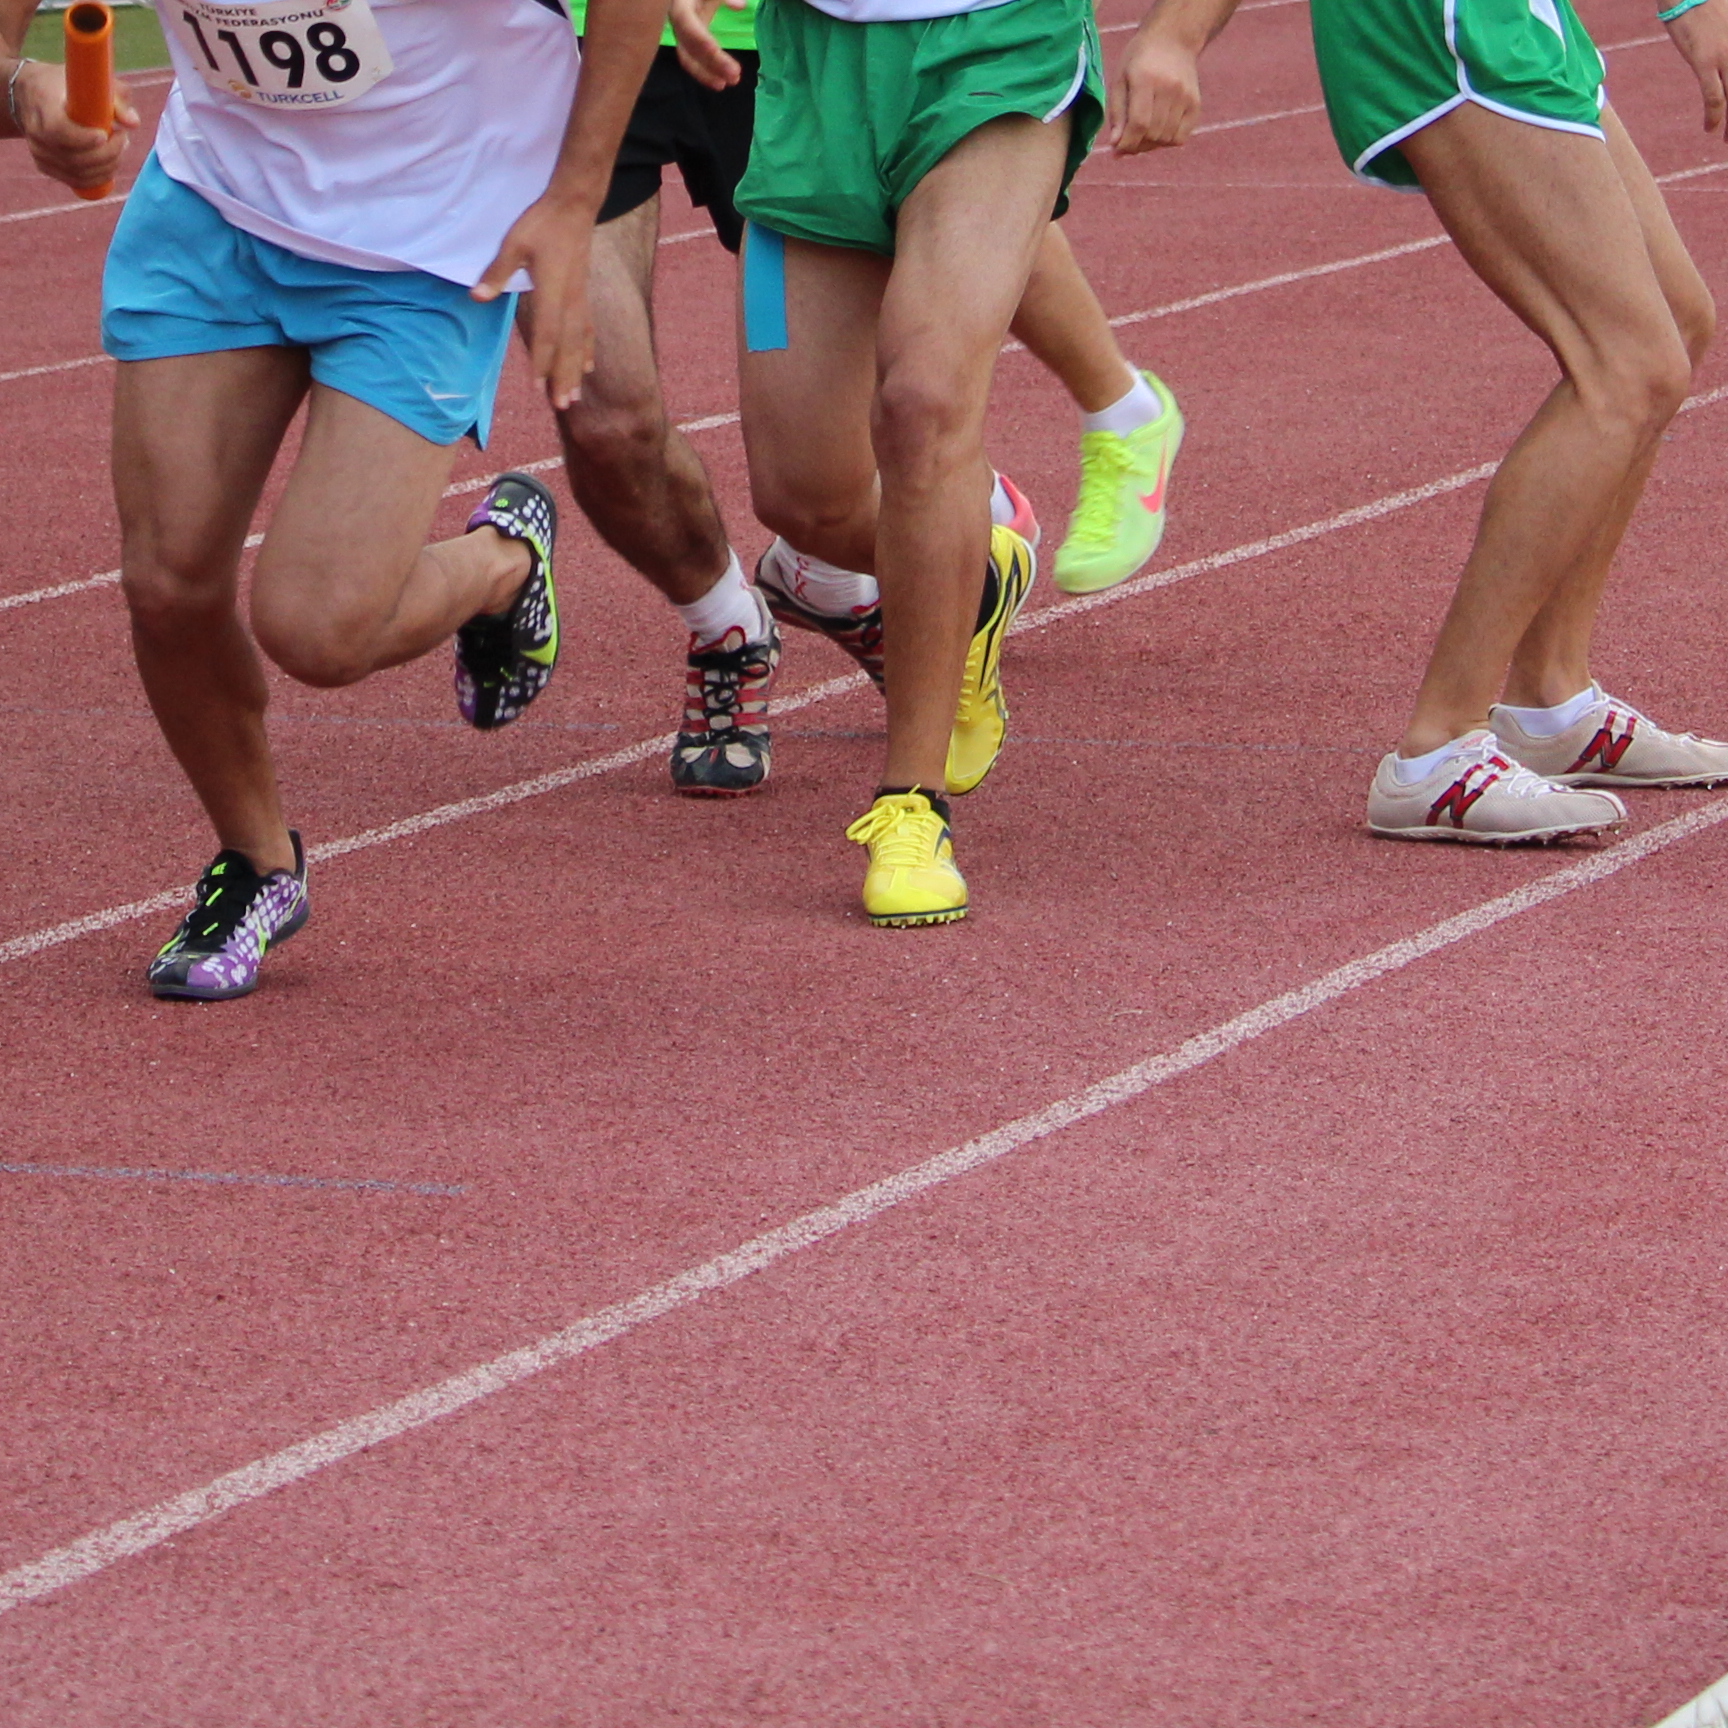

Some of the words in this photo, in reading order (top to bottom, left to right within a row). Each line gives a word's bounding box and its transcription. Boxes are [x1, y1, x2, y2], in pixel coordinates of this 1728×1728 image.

[199, 2, 257, 18] TÜRKİYE
[215, 9, 325, 28] FEDERASYONU
[183, 10, 360, 89] 1198
[256, 89, 344, 105] TURKCELL
